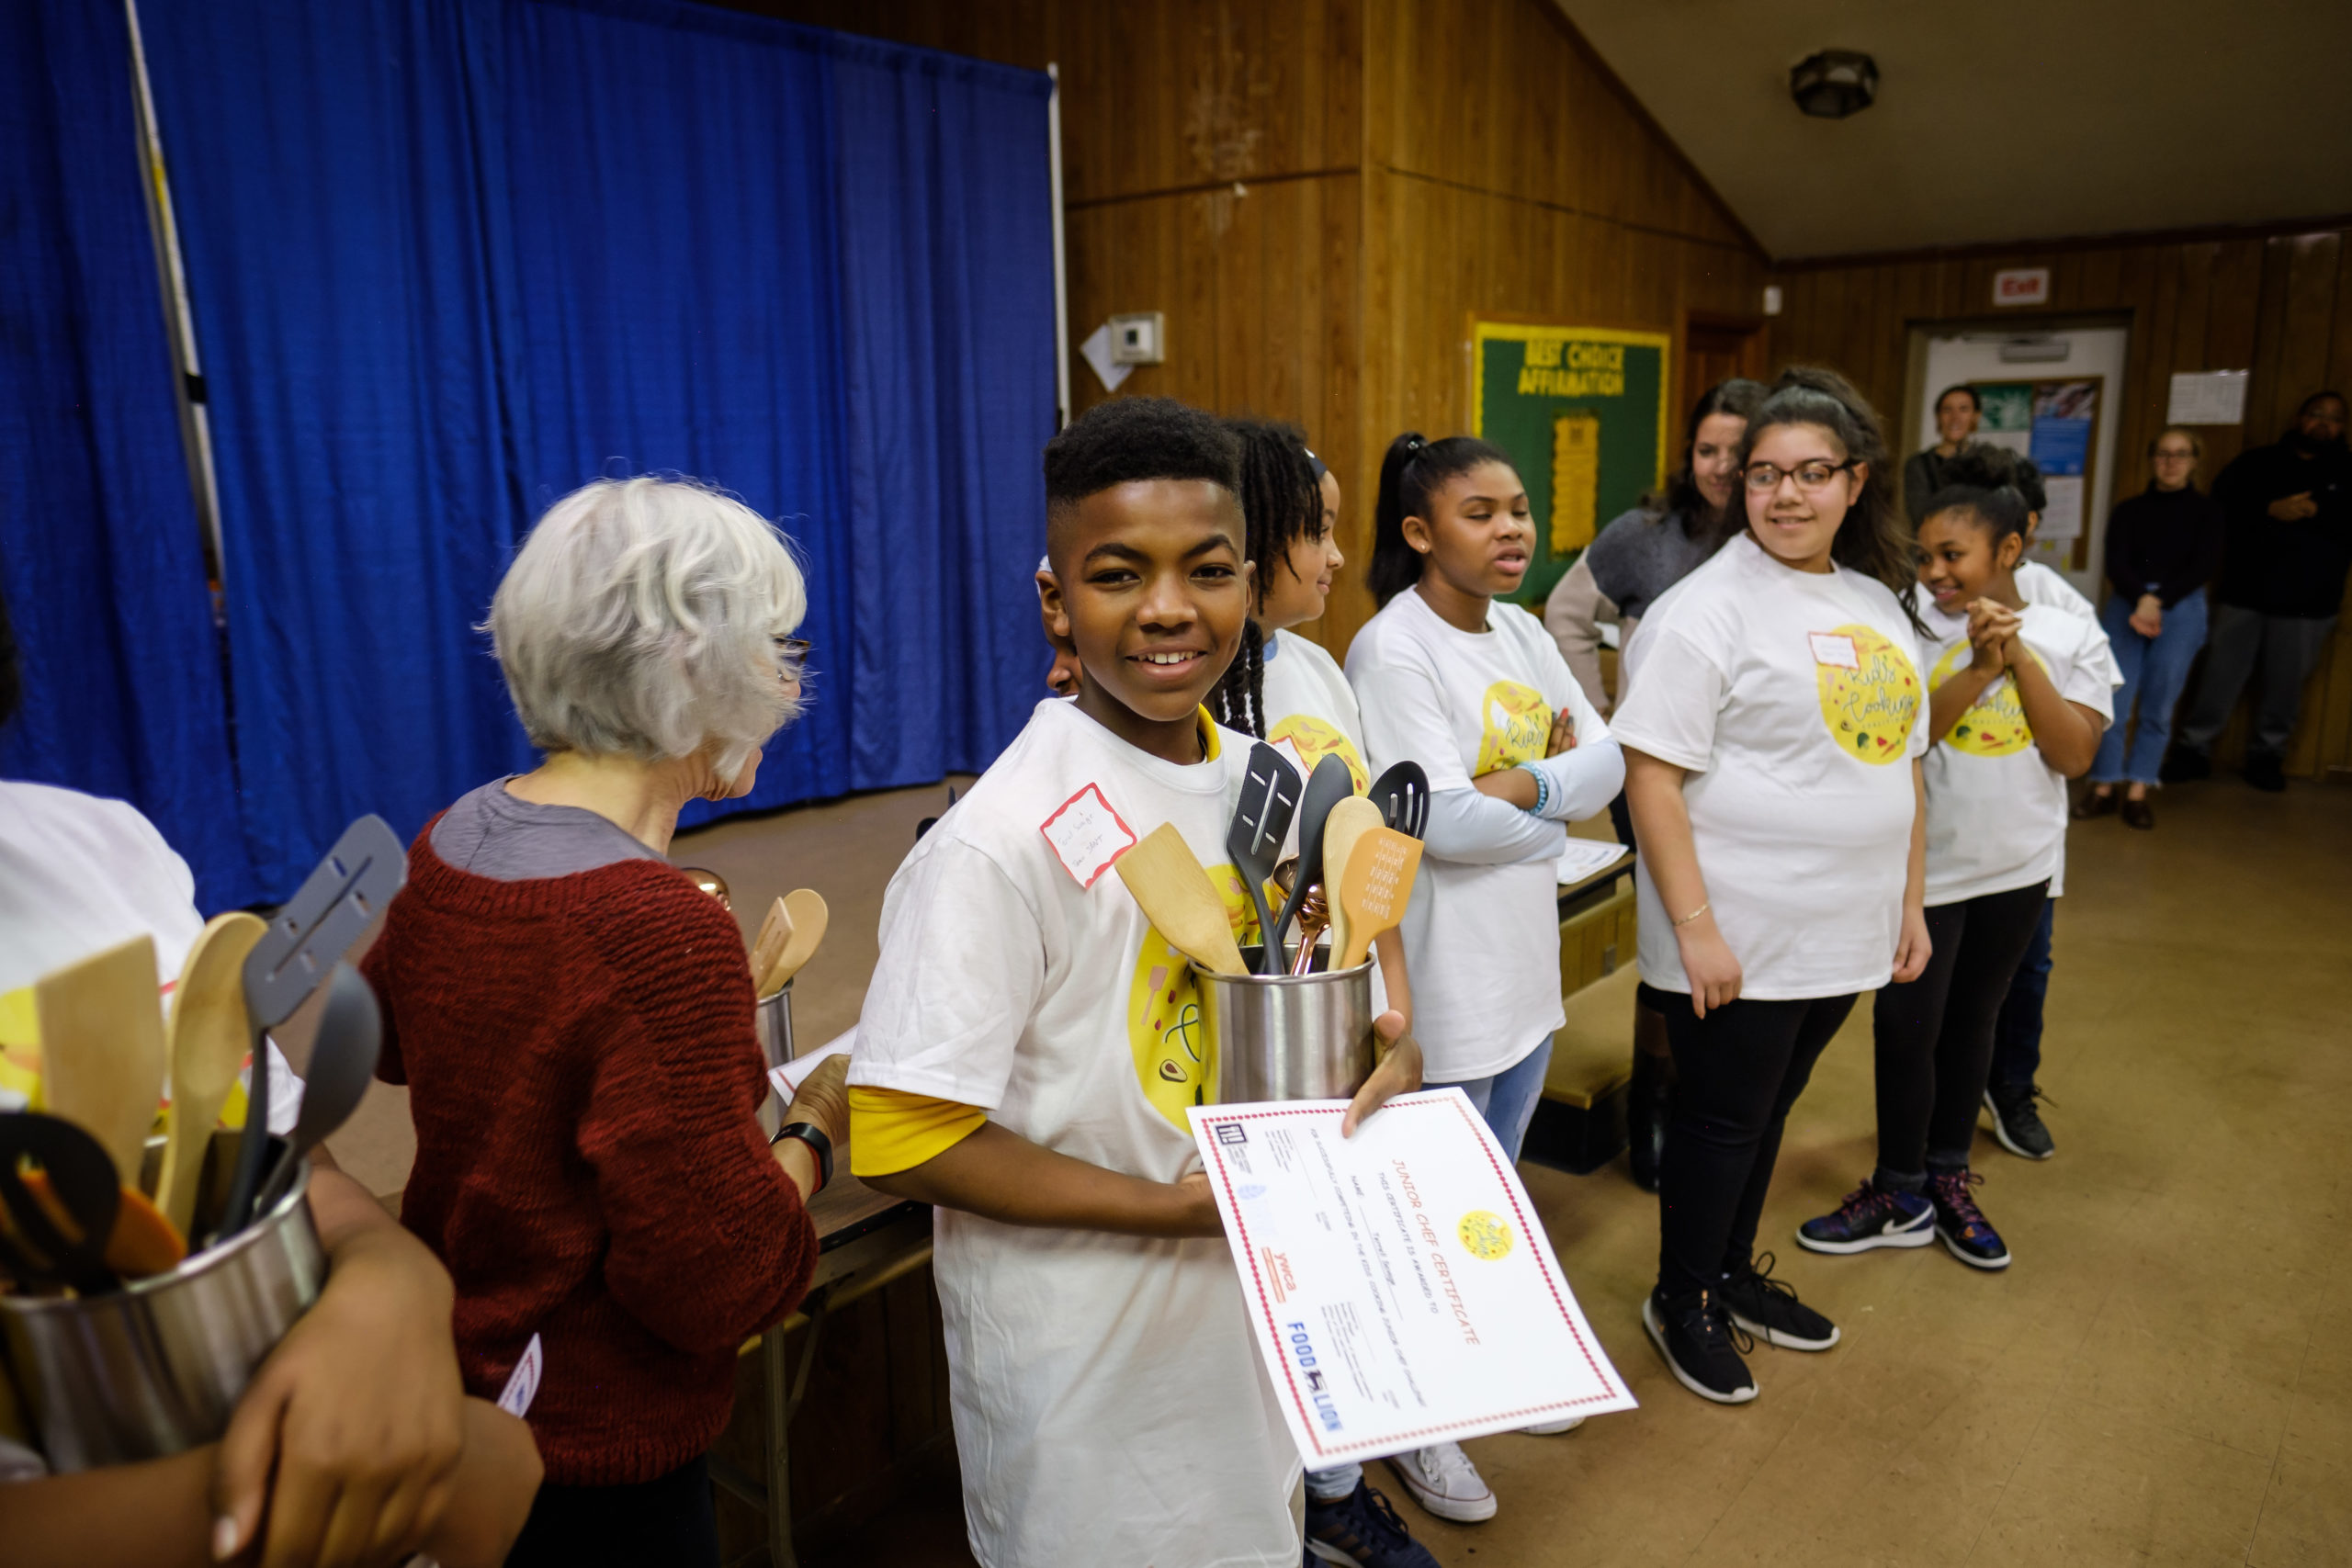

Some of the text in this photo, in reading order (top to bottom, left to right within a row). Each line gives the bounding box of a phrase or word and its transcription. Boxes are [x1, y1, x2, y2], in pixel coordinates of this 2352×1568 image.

[1566, 343, 1624, 371] CHOICE
[1272, 1253, 1296, 1292] ywca
[1378, 1172, 1439, 1314] THIS CERTIFICATE IS AWARDED TO
[1392, 1159, 1480, 1345] JUNIOR CHEF CERTIFICATE
[1287, 1322, 1342, 1432] FOOD LION
